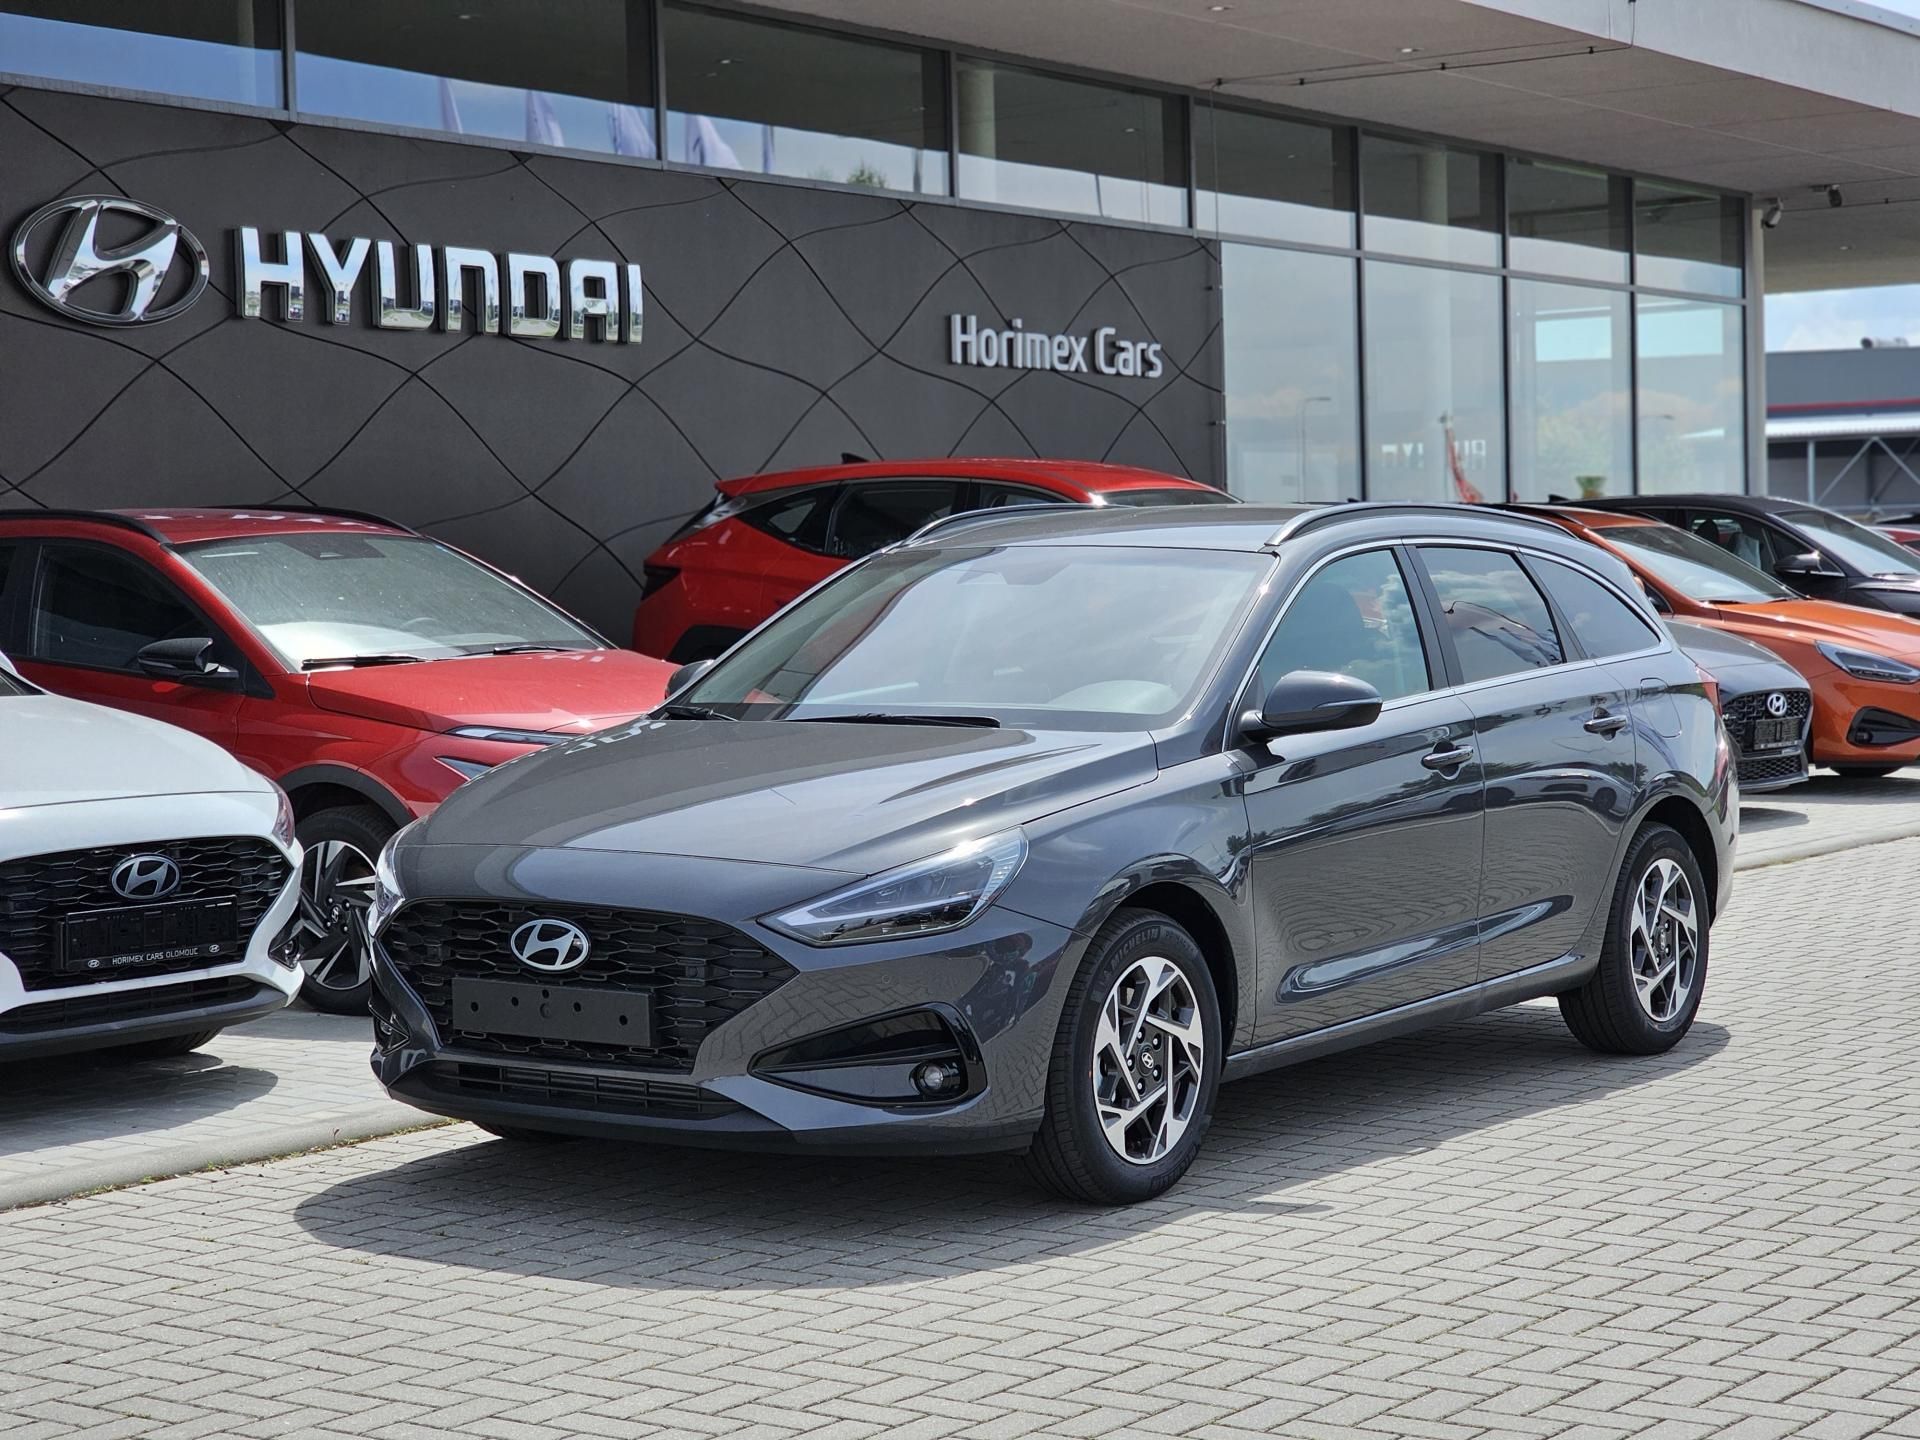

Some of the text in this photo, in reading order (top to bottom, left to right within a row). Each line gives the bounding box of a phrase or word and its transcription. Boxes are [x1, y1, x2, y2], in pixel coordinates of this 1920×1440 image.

[236, 225, 643, 345] HYUNDAI
[949, 313, 1163, 378] Horimex Cars
[112, 947, 199, 965] HORIMEX CARS OLOMOUC
[1110, 926, 1160, 971] MICHELIN
